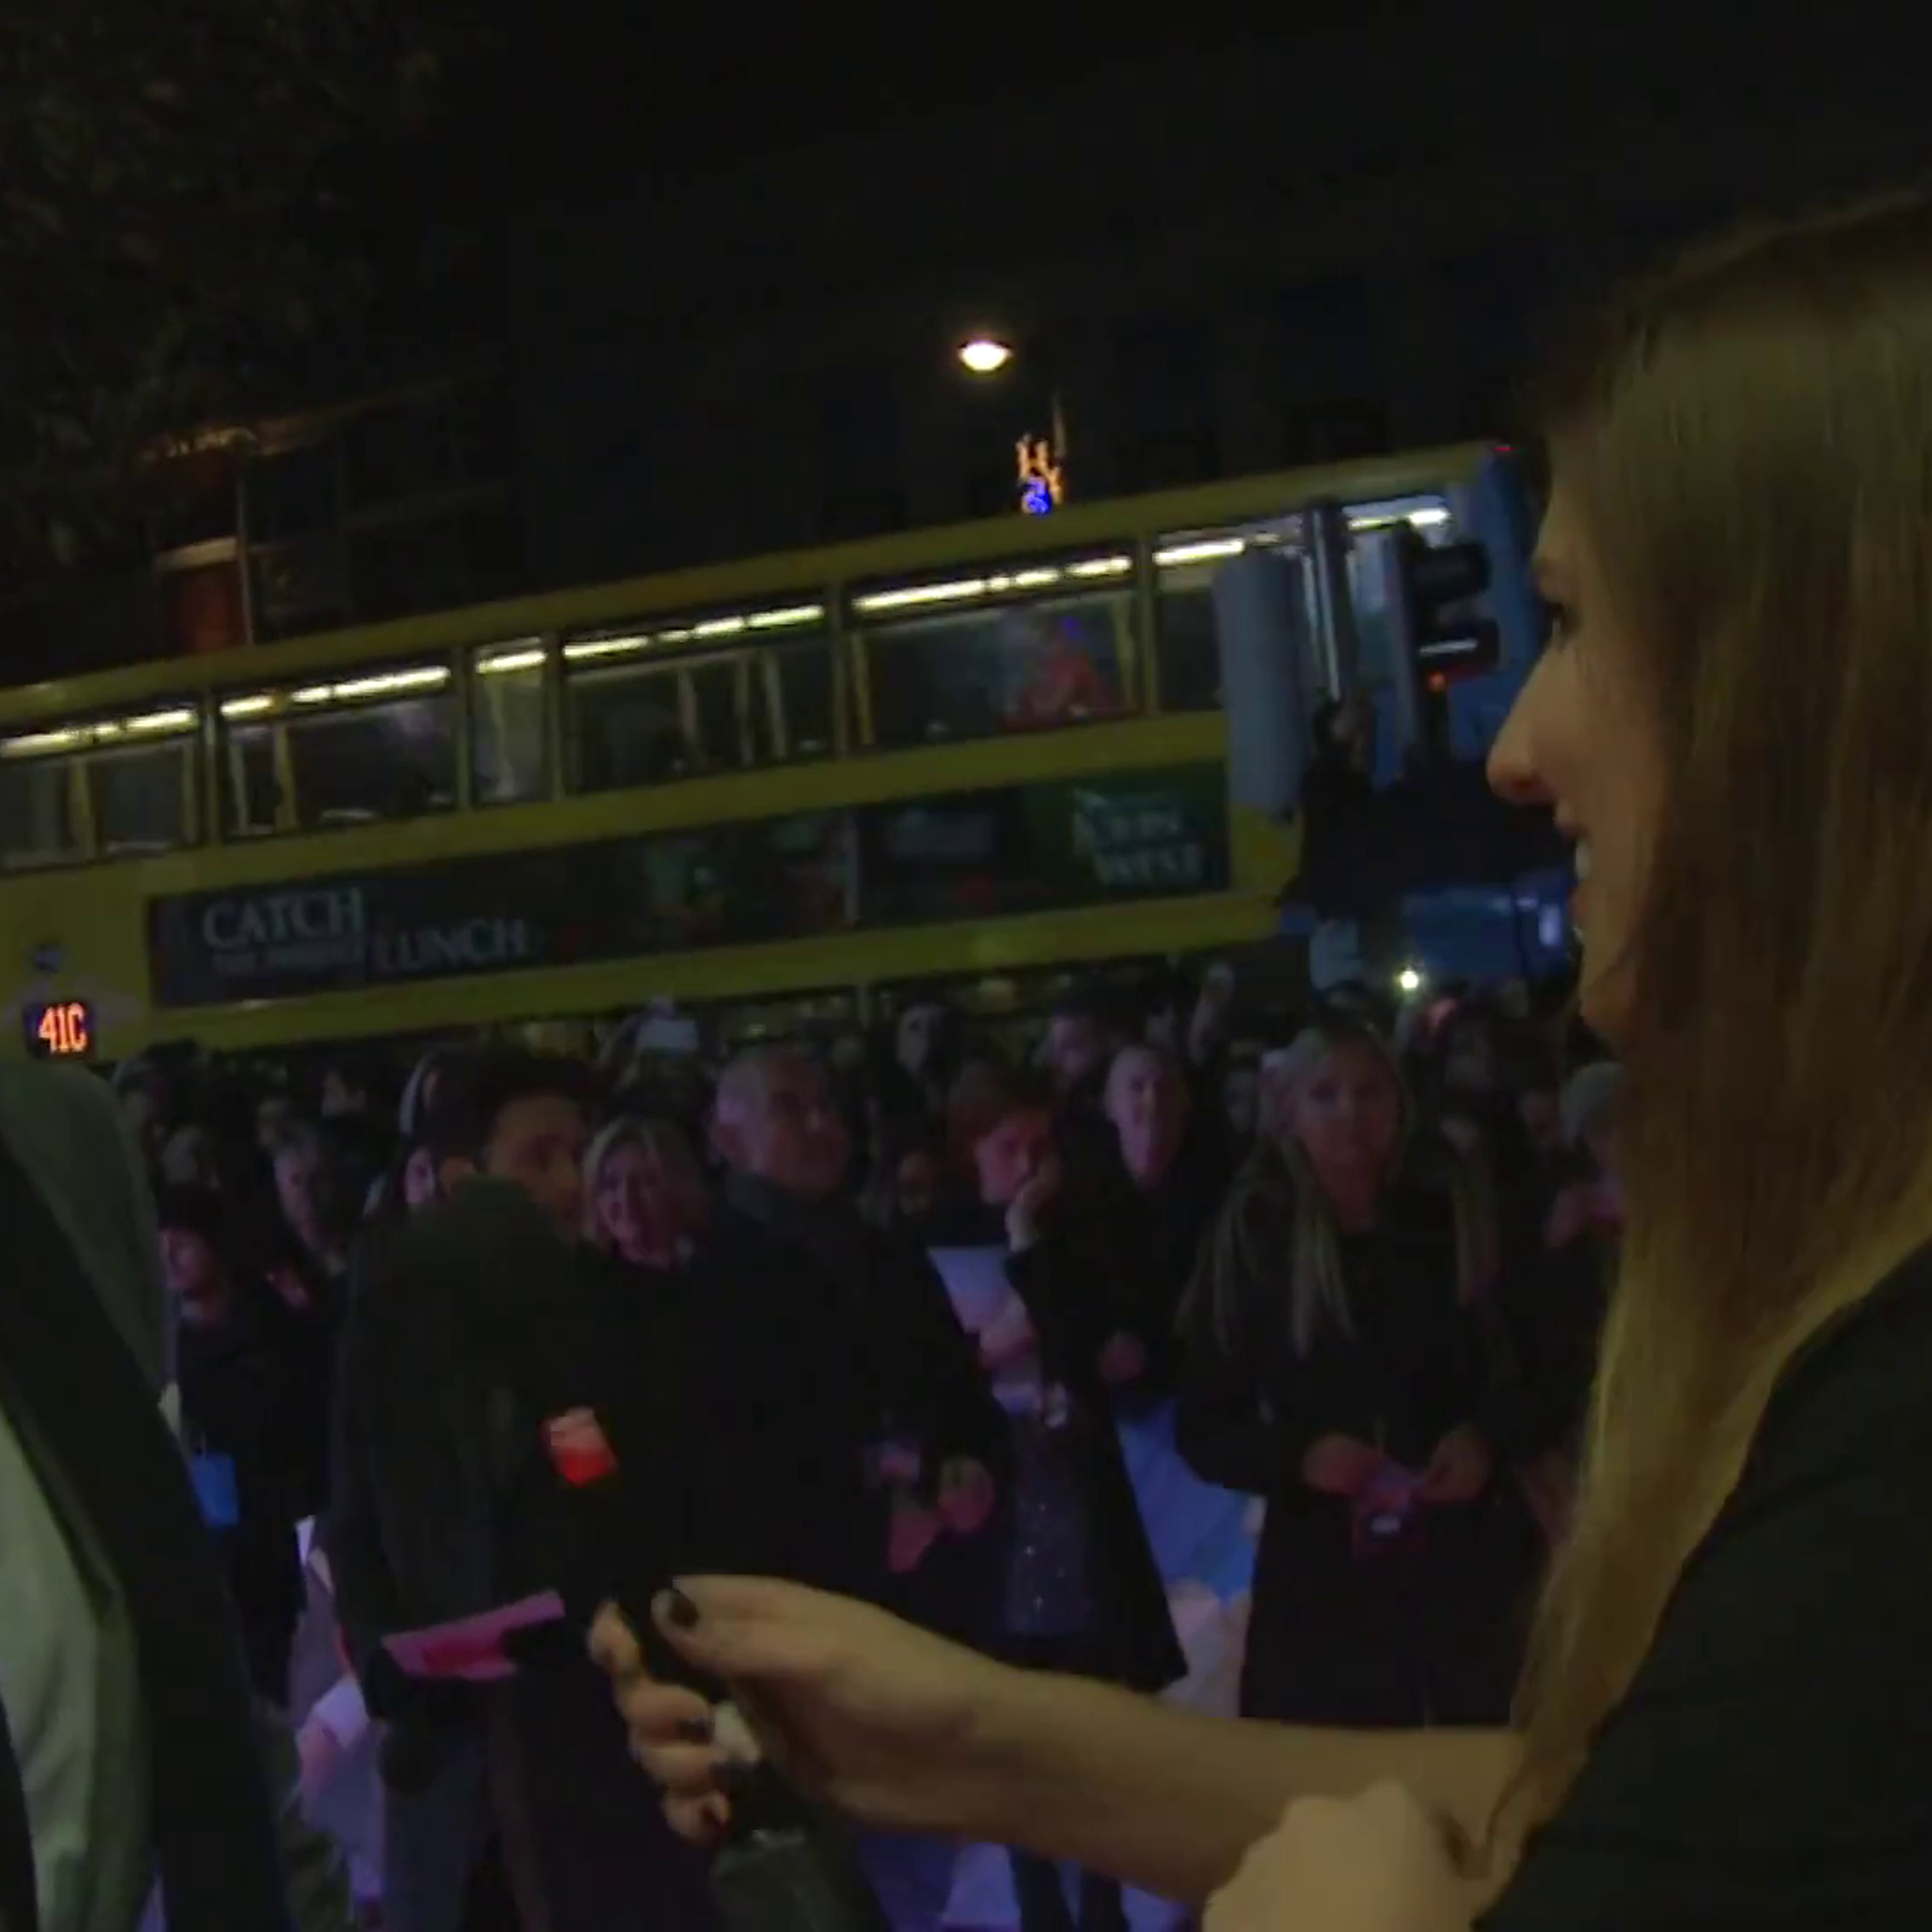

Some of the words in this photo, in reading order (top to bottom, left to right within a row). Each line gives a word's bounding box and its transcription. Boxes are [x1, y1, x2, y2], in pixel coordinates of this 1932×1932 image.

[202, 886, 363, 950] CATCH
[372, 916, 528, 971] LUNCH
[39, 1002, 88, 1054] 41C
